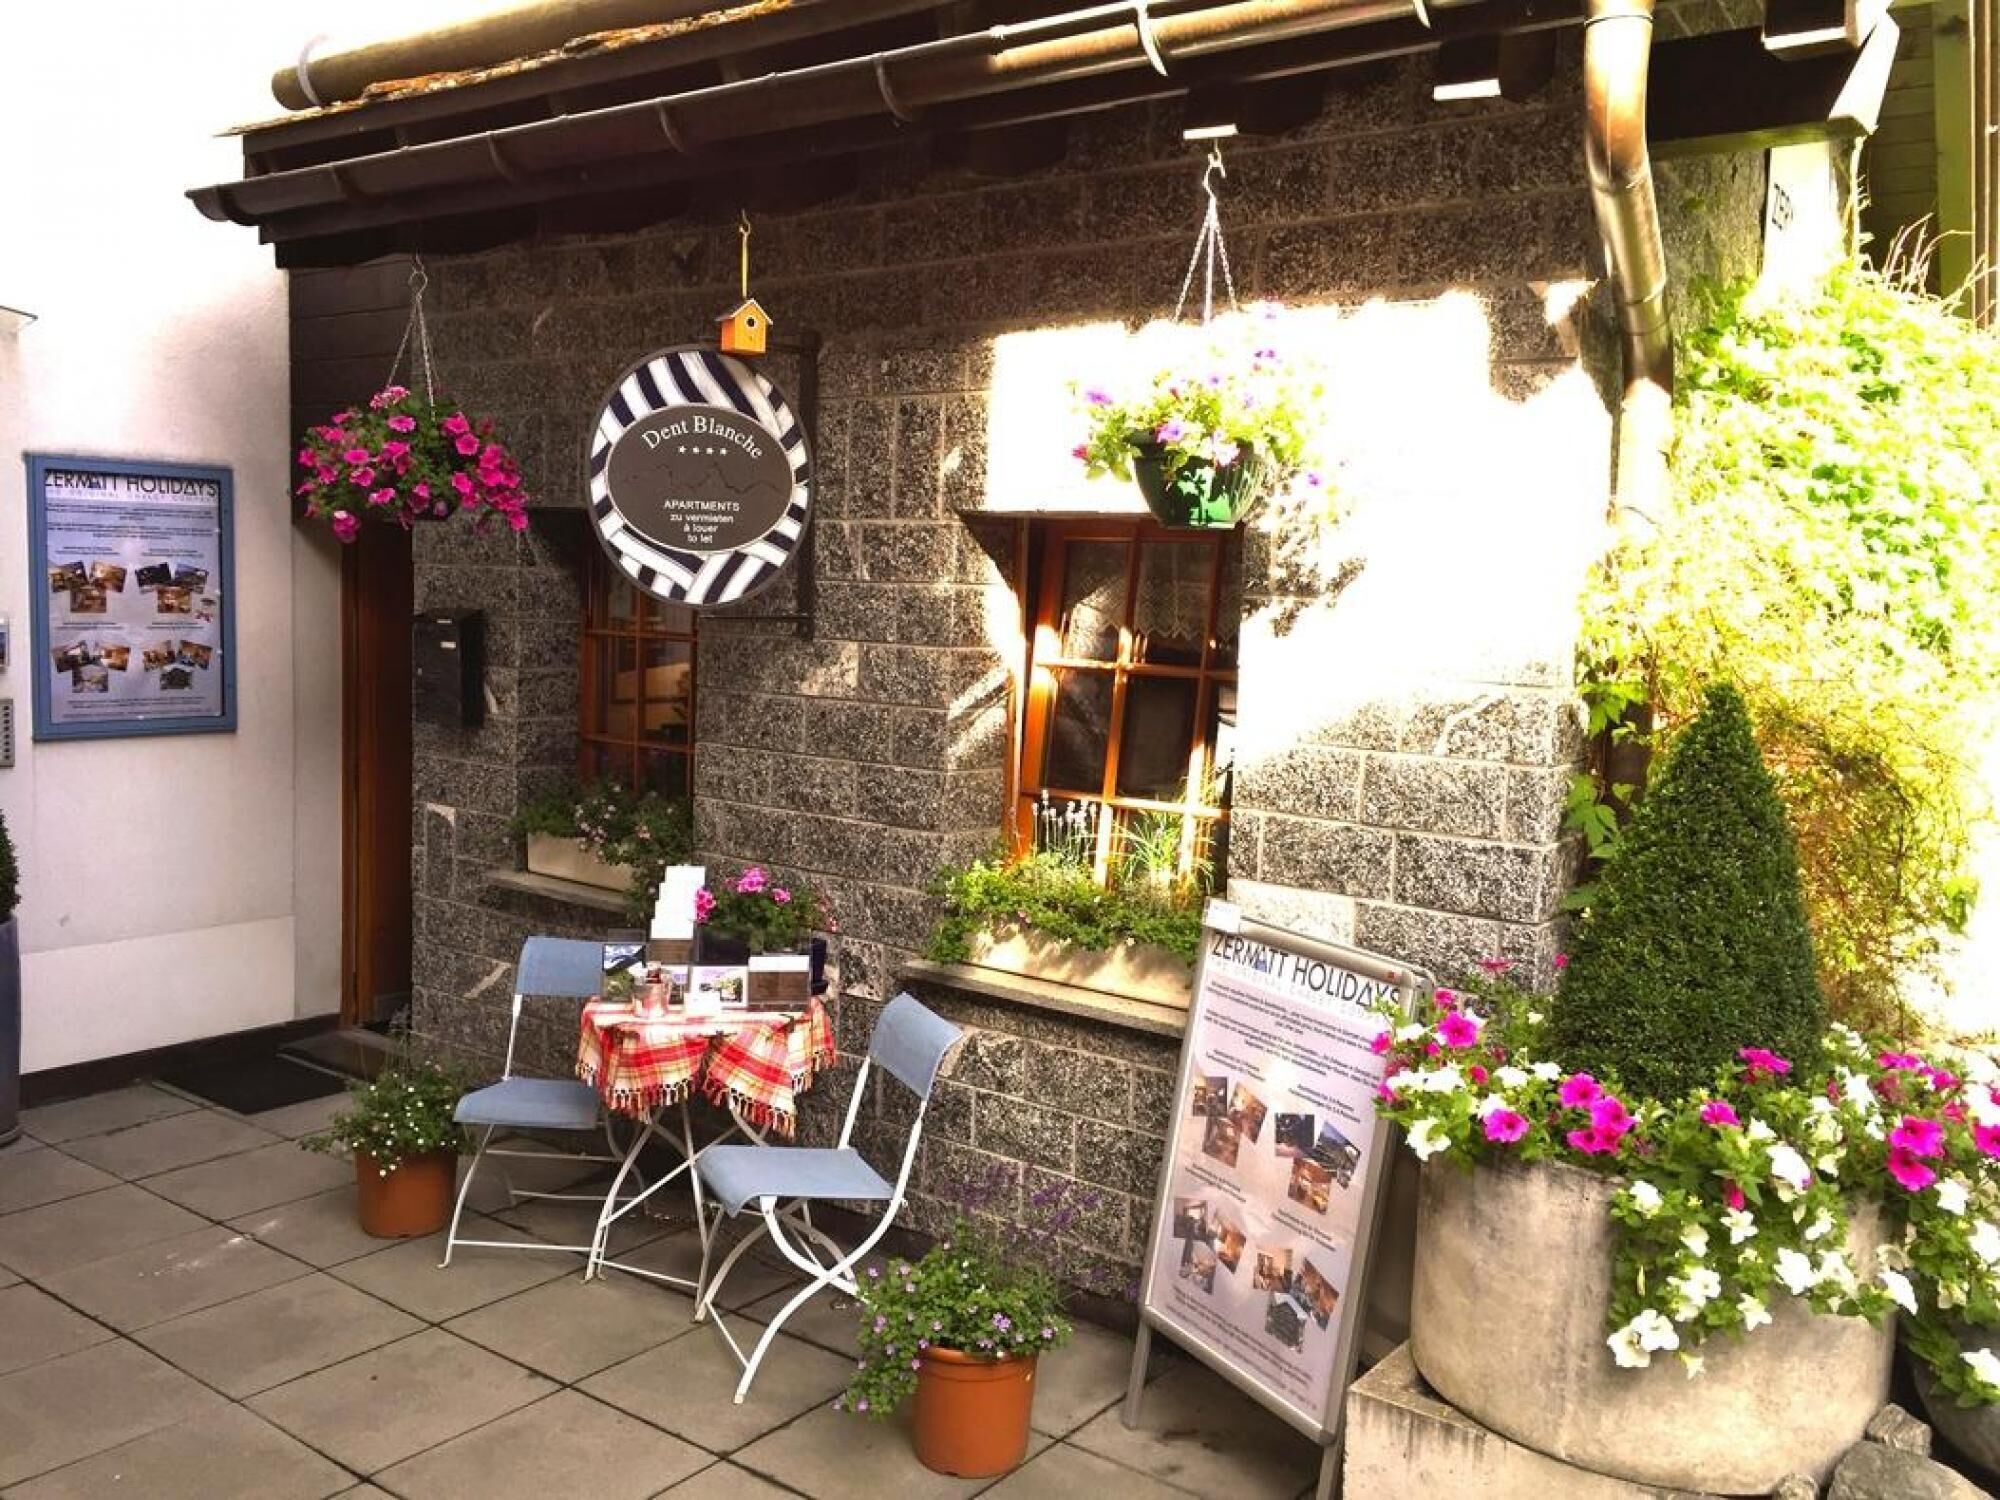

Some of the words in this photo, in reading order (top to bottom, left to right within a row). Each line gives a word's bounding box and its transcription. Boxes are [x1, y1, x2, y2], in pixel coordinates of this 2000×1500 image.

[642, 420, 689, 449] Dent
[693, 415, 762, 458] Blanche
[45, 472, 118, 491] ZERMATT
[126, 475, 216, 497] HOLIDAYS
[664, 499, 740, 511] APARTMENTS
[693, 523, 718, 532] louer
[688, 534, 698, 542] to
[700, 534, 713, 543] let
[1213, 932, 1289, 978] ZERMATT
